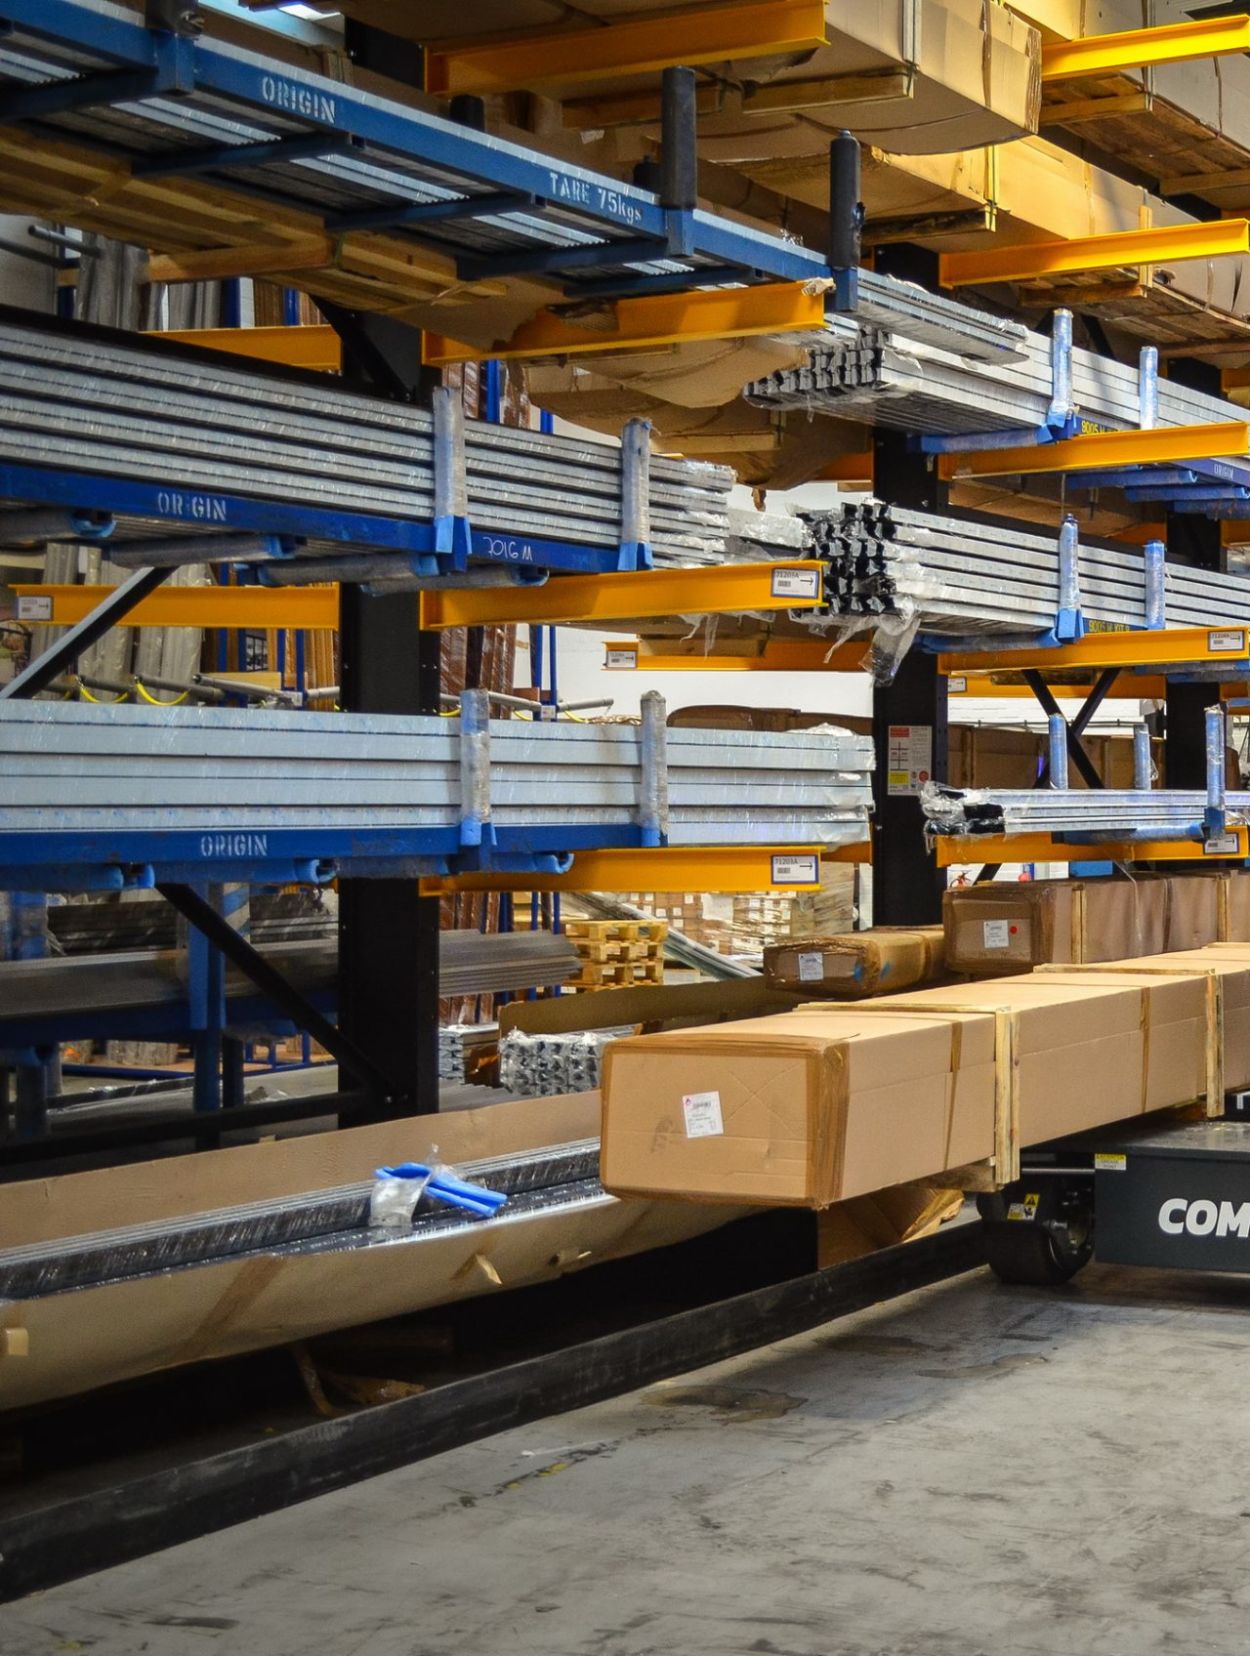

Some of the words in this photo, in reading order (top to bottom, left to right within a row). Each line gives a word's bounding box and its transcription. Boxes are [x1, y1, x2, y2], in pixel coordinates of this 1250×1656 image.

[262, 76, 336, 124] ORIGIN
[549, 171, 590, 205] TARE
[597, 187, 643, 225] 75kgs
[201, 834, 267, 857] ORIGIN
